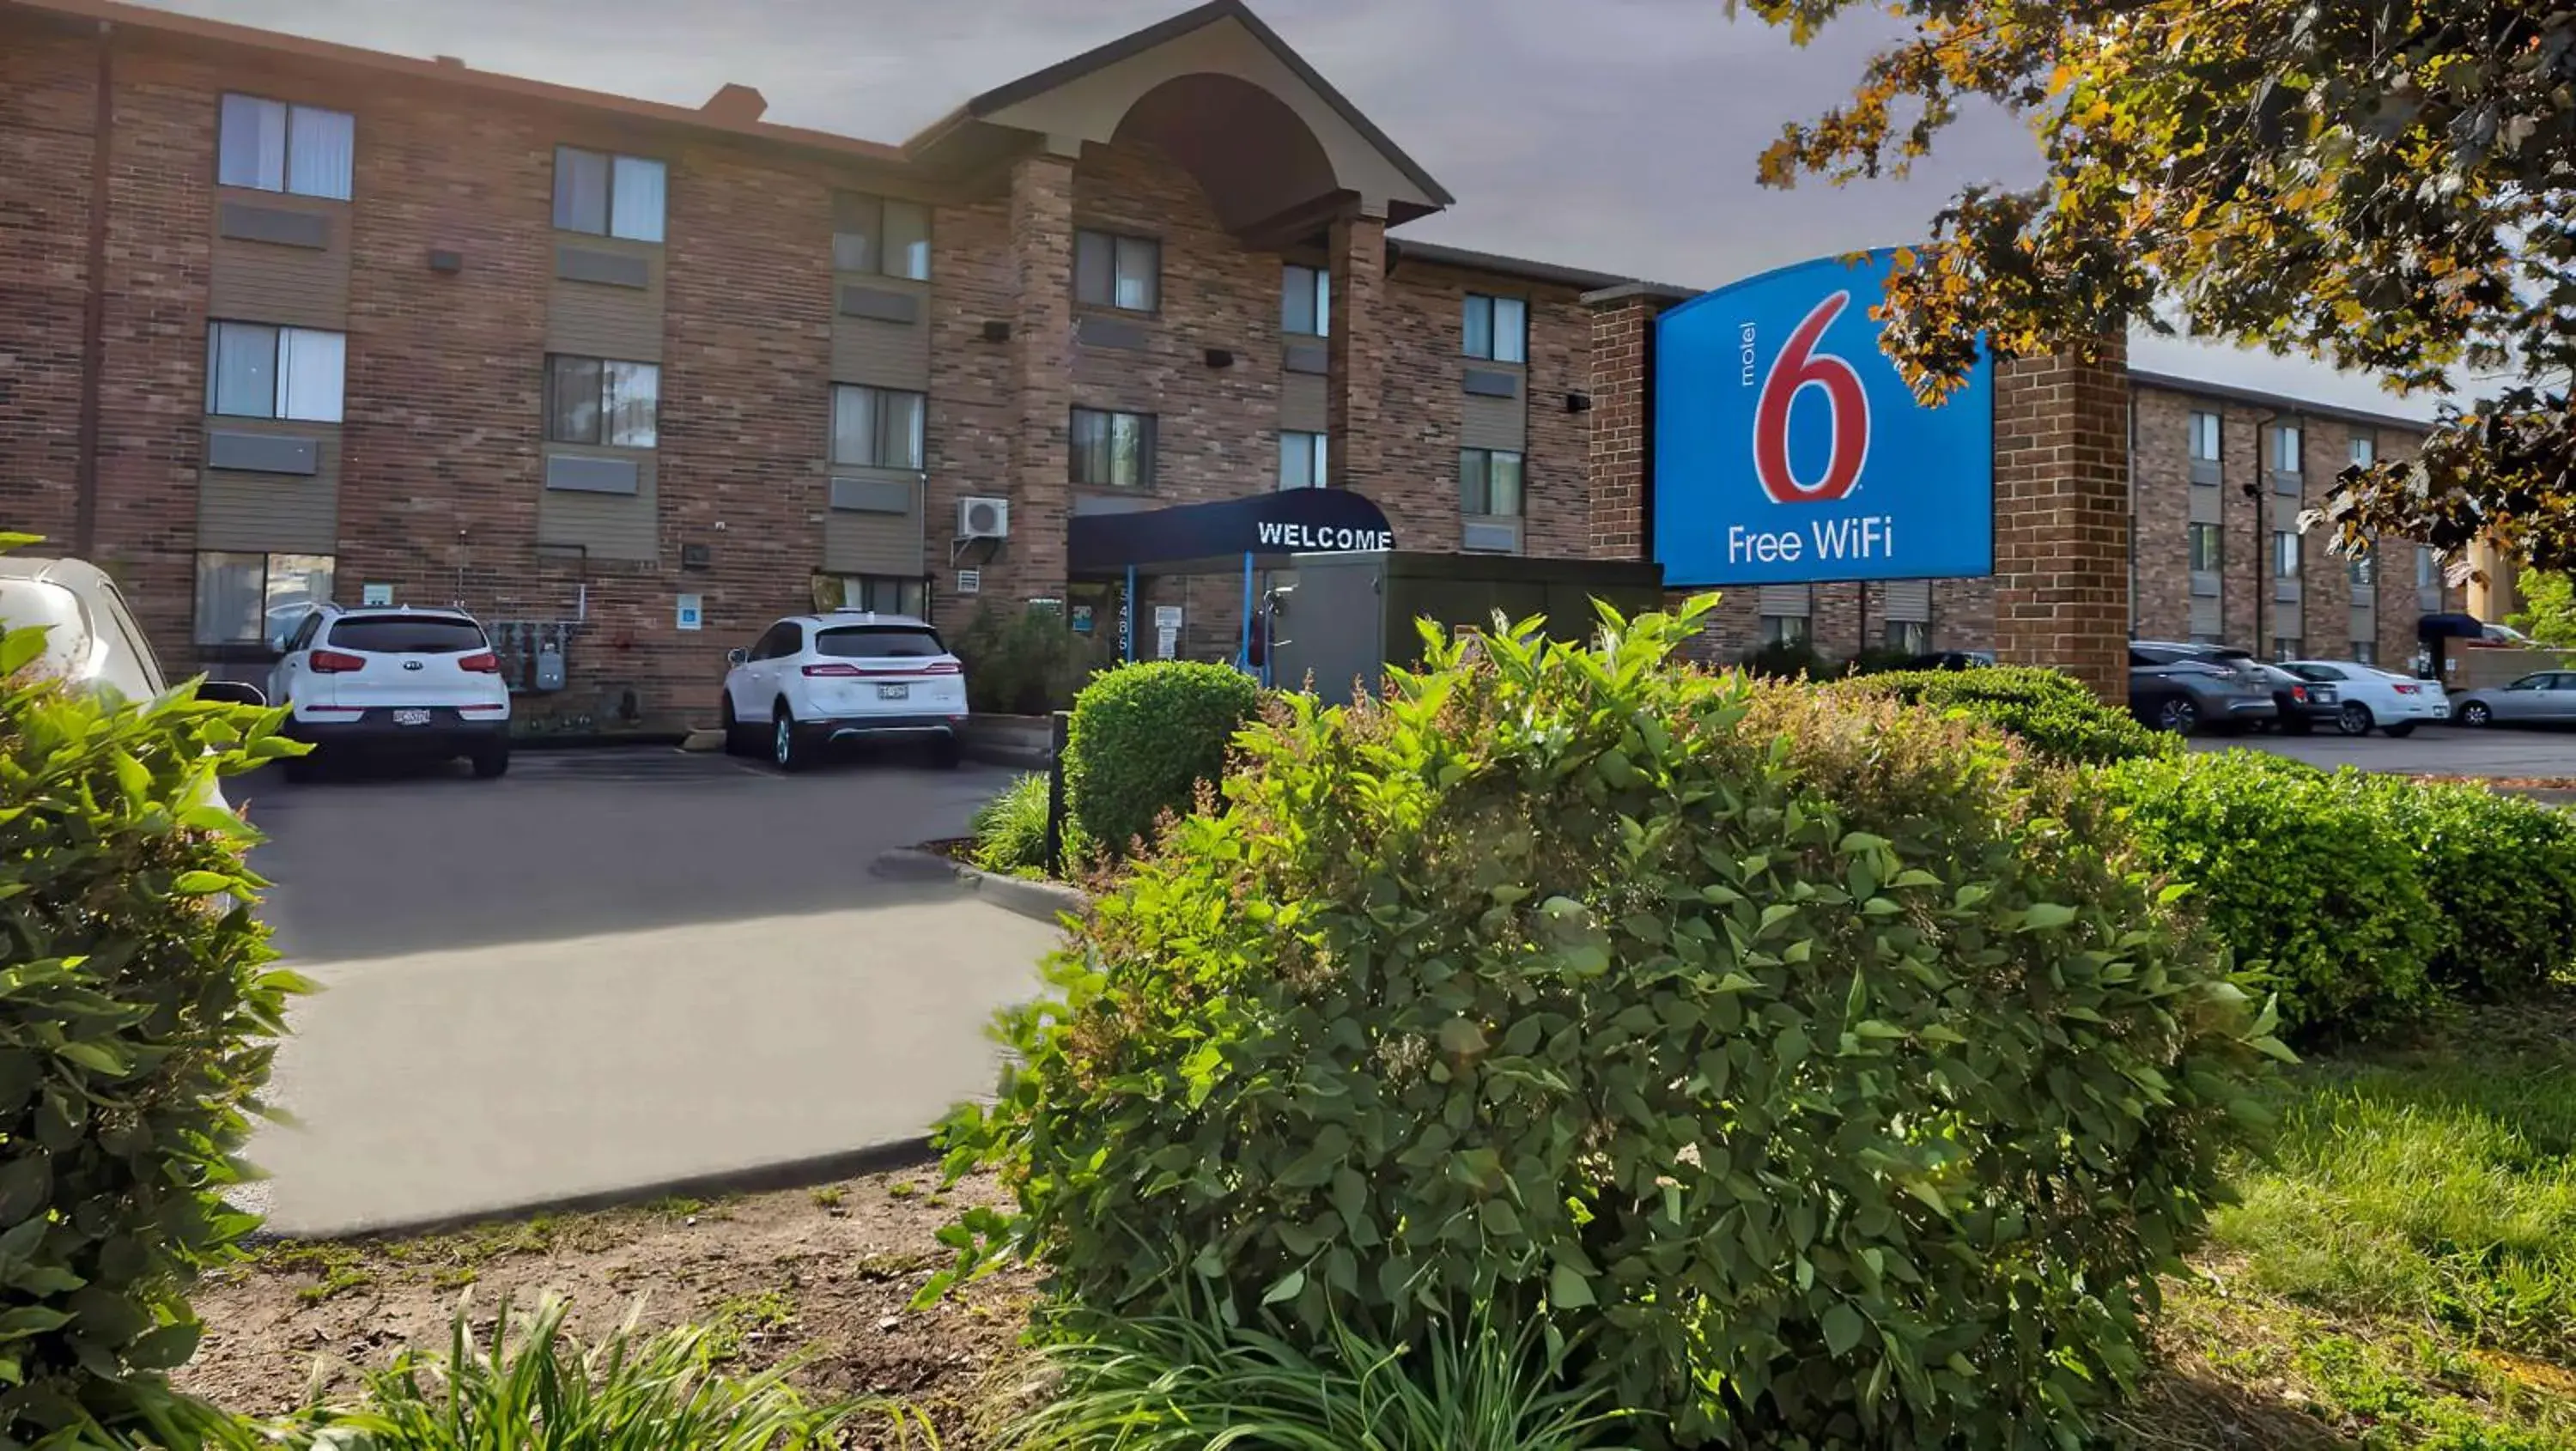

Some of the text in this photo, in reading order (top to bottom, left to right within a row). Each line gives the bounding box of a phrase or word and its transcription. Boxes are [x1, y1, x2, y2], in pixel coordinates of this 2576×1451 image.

[1739, 322, 1755, 386] motel
[1753, 289, 1870, 503] 6
[1258, 521, 1392, 551] WELCOME
[1728, 517, 1893, 563] Free WiFi
